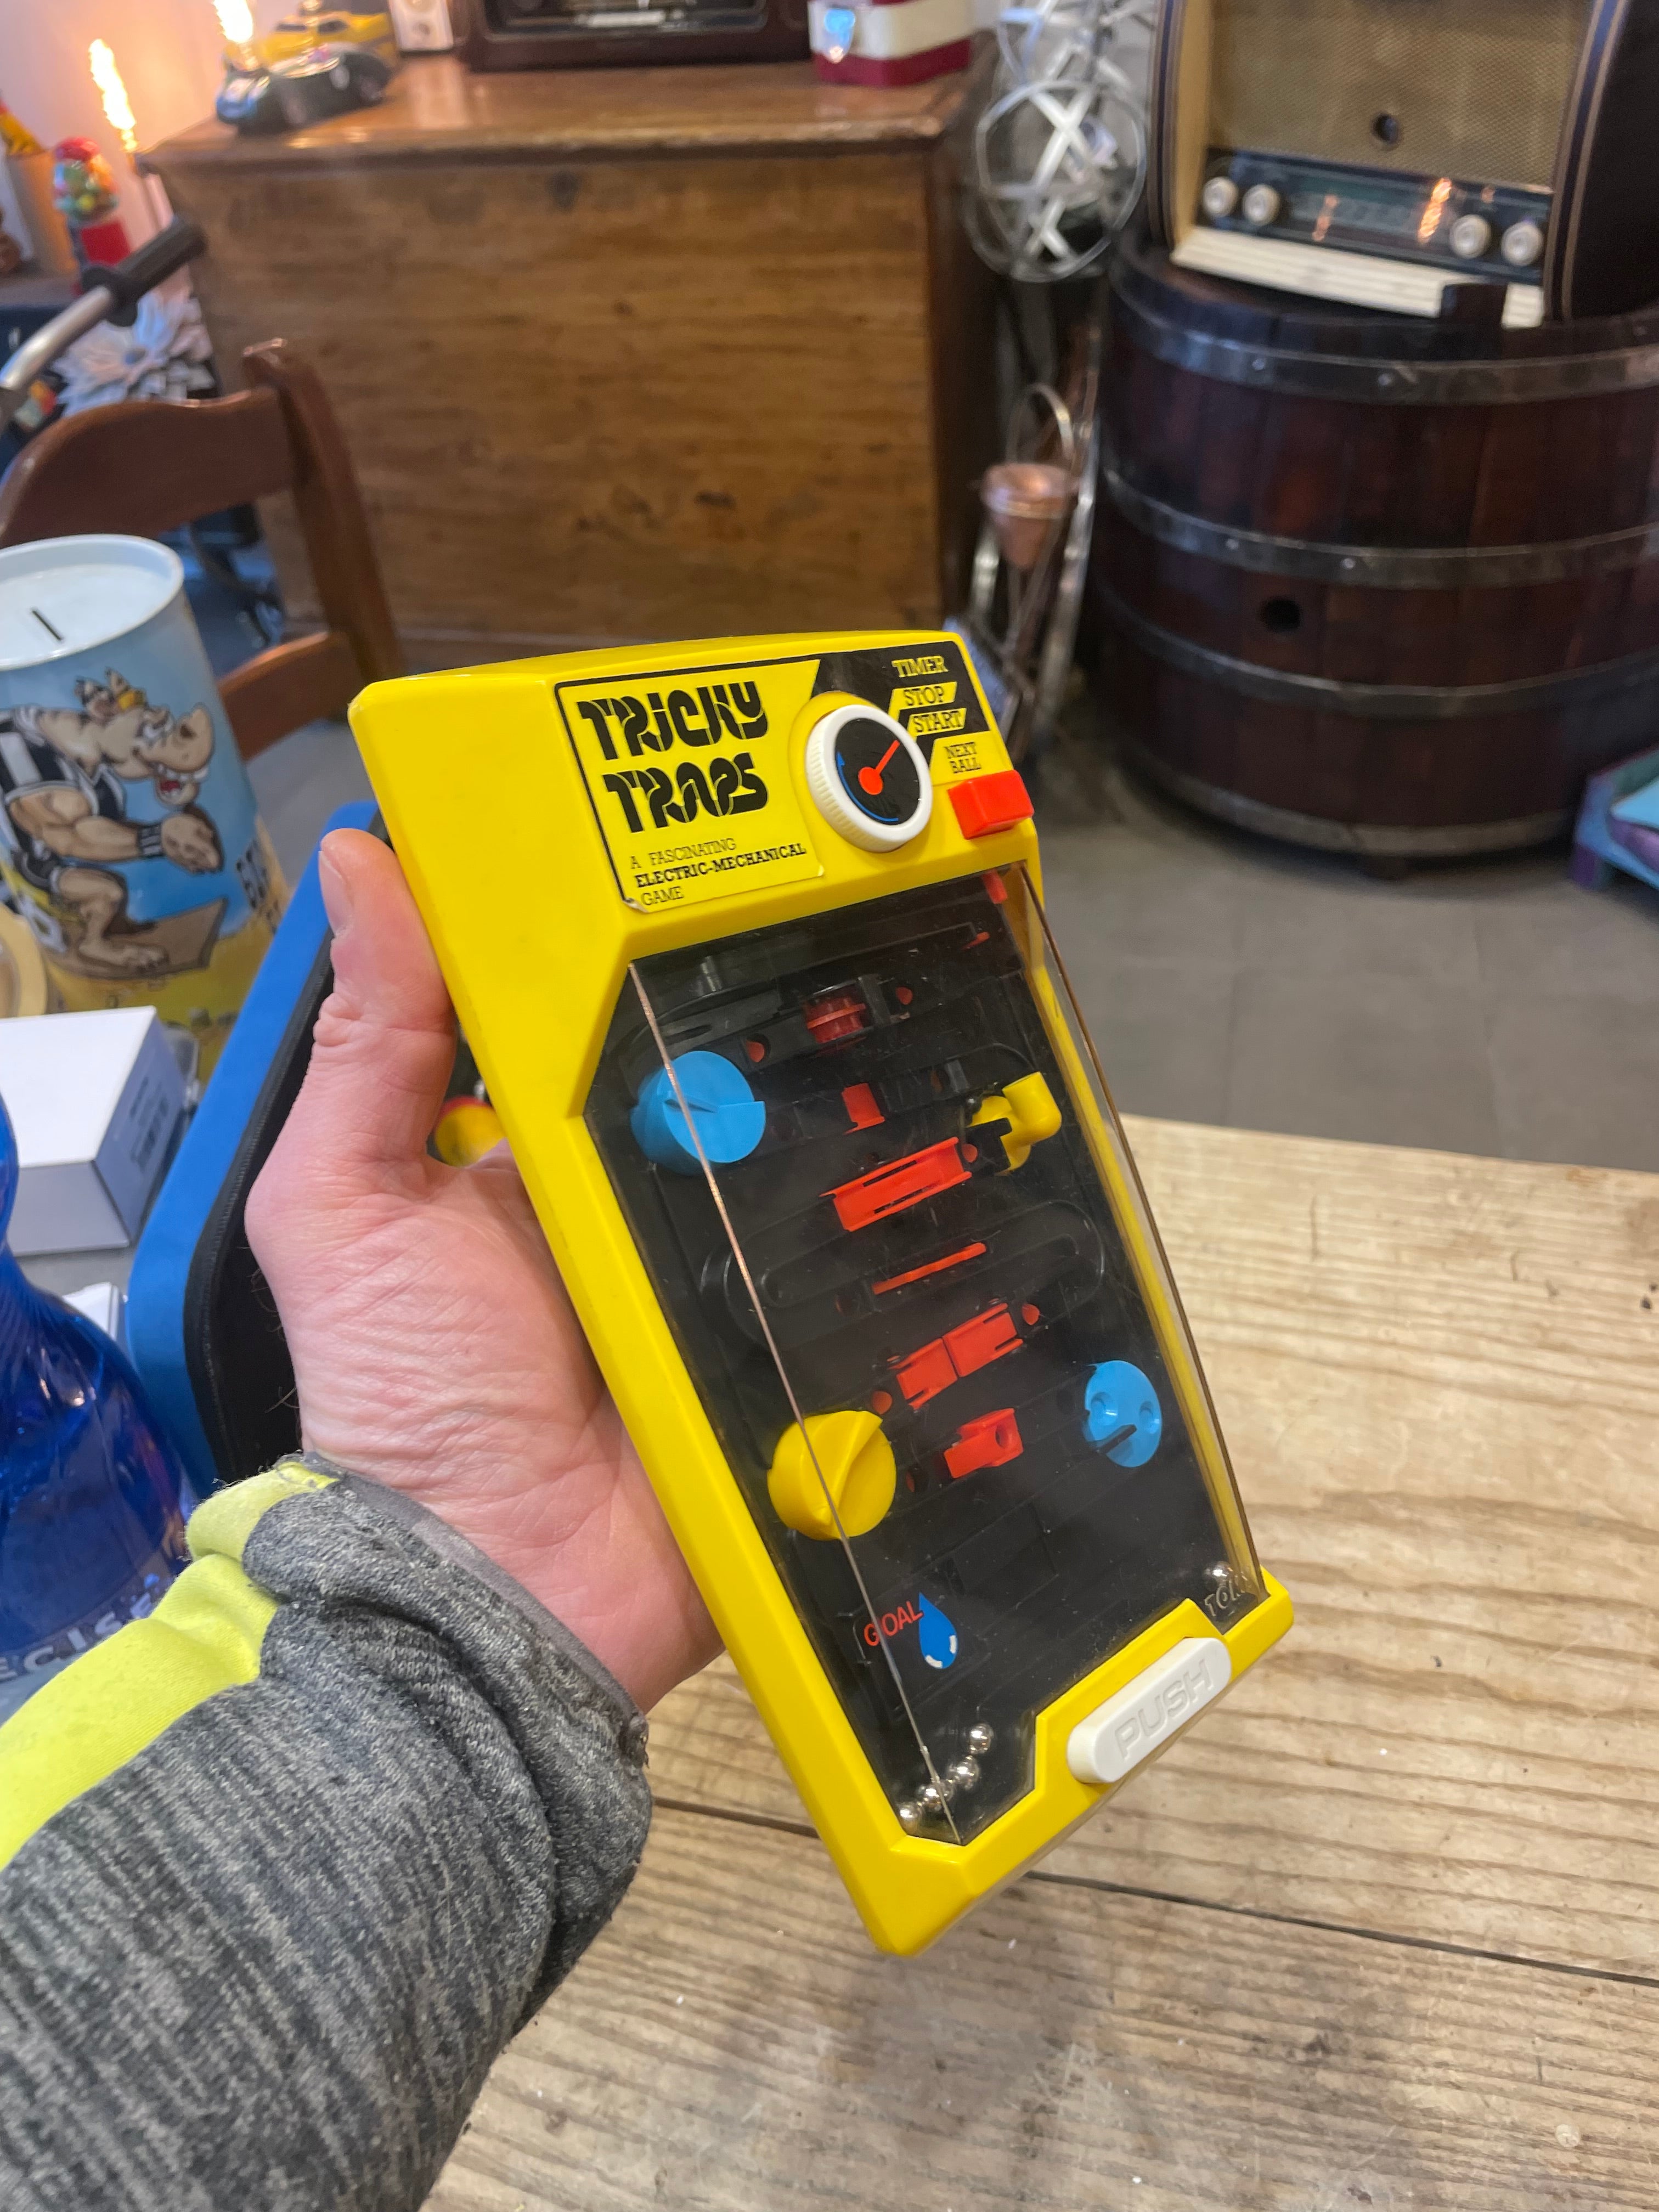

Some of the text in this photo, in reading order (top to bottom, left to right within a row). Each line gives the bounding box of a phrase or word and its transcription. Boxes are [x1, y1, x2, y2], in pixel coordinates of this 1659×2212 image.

[891, 656, 949, 678] TIMER
[904, 686, 944, 706] STOP
[577, 681, 769, 760] TRICKY
[913, 710, 963, 732] START
[944, 742, 977, 759] NEXT
[950, 758, 982, 774] BALL
[602, 752, 769, 833] TRAPS
[631, 838, 737, 870] A FASCINATING
[634, 843, 806, 888] ELECTRIC-MECHANICAL
[641, 886, 684, 905] GAME
[864, 1601, 923, 1646] GOAL
[1114, 1658, 1214, 1760] PUSH
